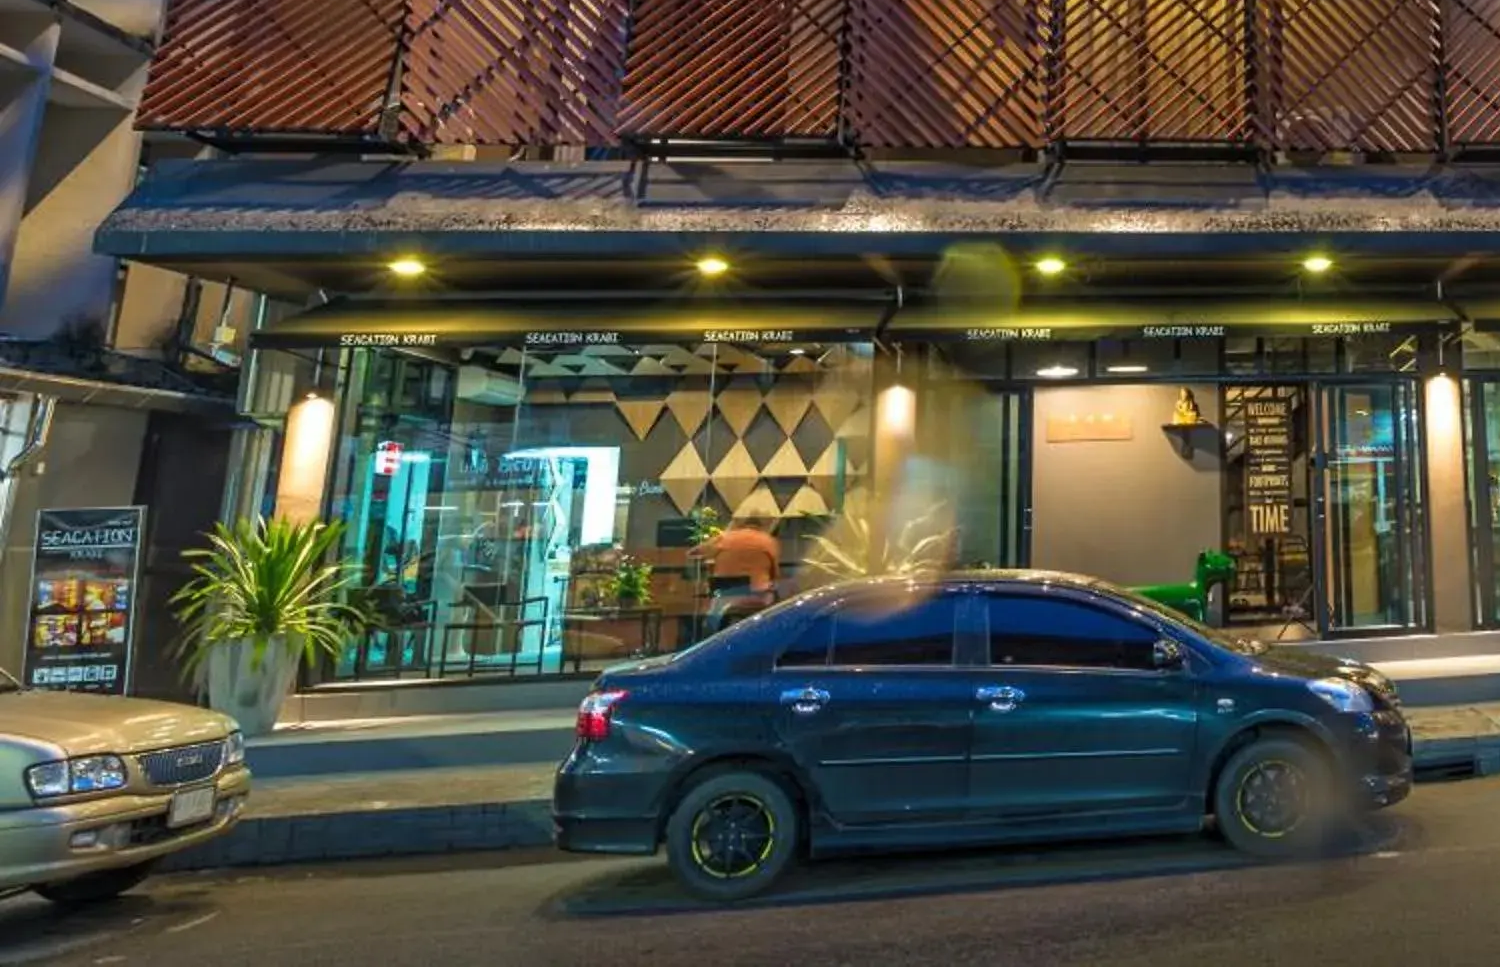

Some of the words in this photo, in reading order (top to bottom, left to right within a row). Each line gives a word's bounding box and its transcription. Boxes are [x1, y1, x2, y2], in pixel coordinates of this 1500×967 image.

[1247, 402, 1286, 415] WELCOME
[1249, 504, 1289, 533] TIME
[41, 528, 134, 546] SEACATION
